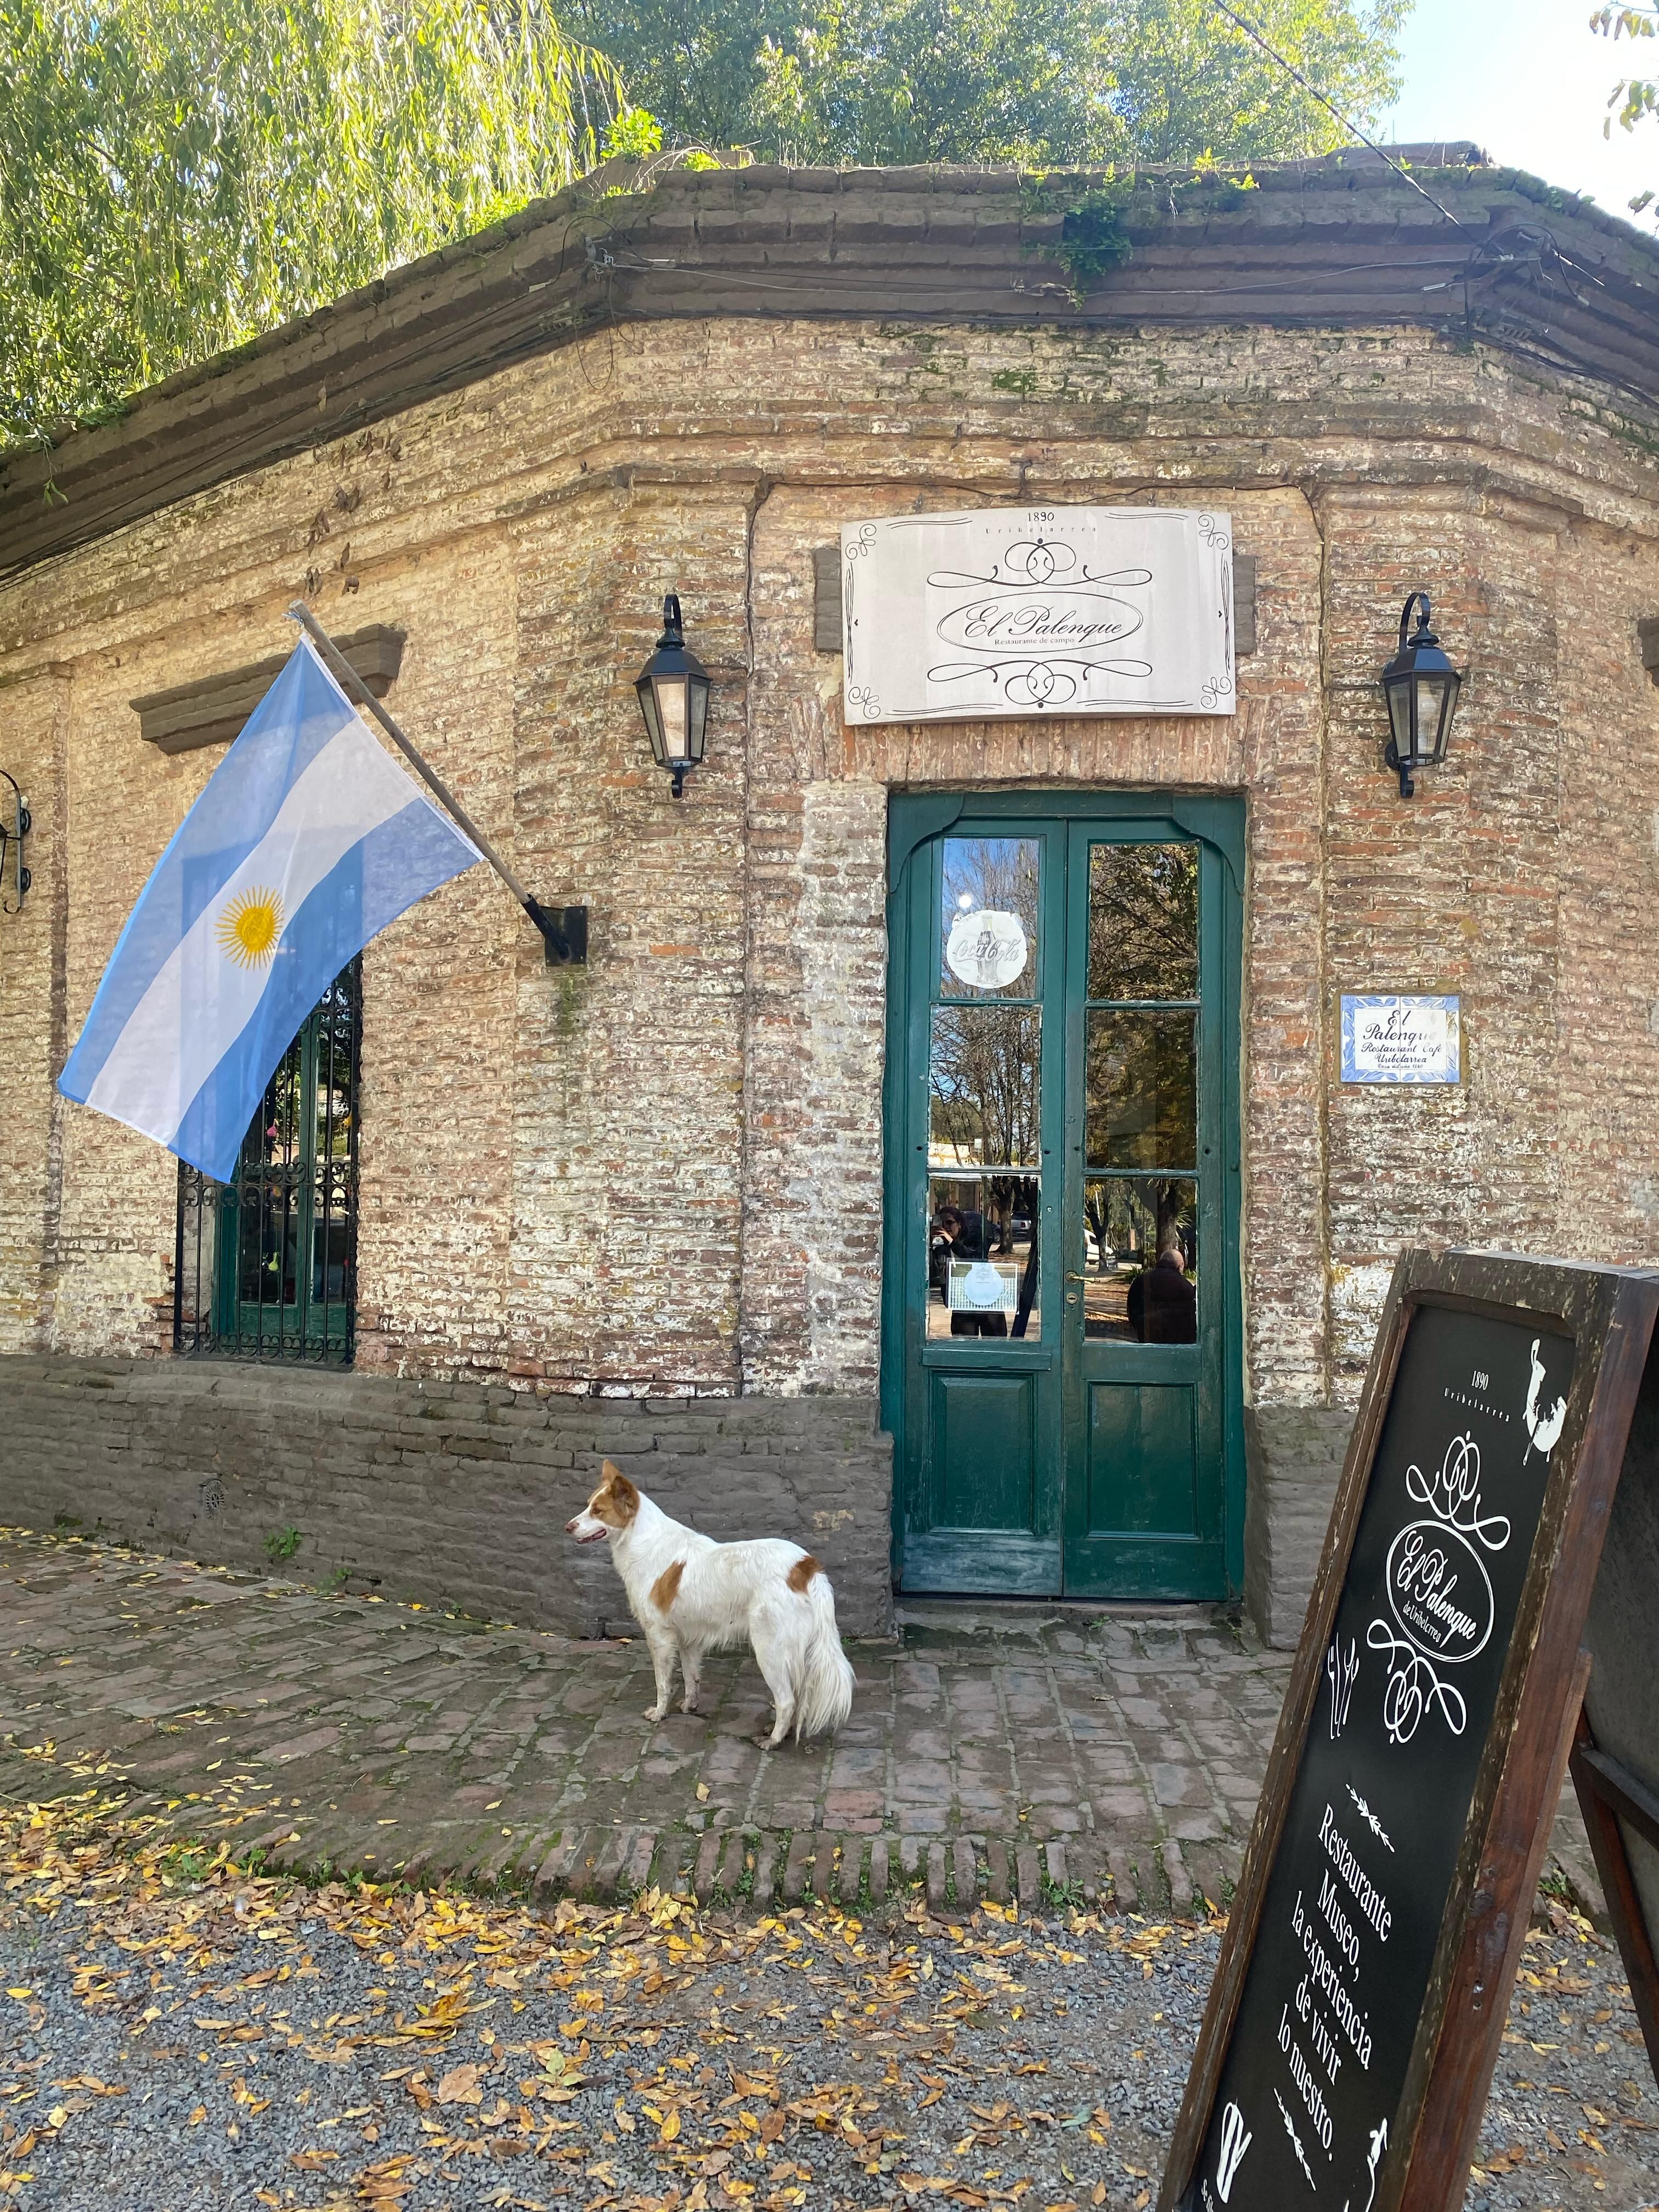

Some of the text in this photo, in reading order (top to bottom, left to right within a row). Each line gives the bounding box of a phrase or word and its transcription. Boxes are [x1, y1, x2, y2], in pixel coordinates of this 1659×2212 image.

[1028, 512, 1054, 522] 1890
[965, 605, 1122, 643] El Palenque
[952, 939, 1022, 962] Coca-Cola
[1387, 1009, 1412, 1026] El
[1361, 1042, 1417, 1053] Restaurant
[1374, 1053, 1427, 1063] Uribelarrea
[1471, 1370, 1489, 1390] 1890
[1444, 1387, 1509, 1421] Uribelarrea
[1397, 1530, 1477, 1648] El Palenque
[1403, 1600, 1411, 1616] de
[1318, 1803, 1391, 1942] Restaurante
[1317, 1868, 1359, 1982] Museo,
[1291, 1891, 1372, 2070] la experiencia
[1296, 1974, 1341, 2085] de vivir
[1277, 2004, 1333, 2162] lo nuestro.
